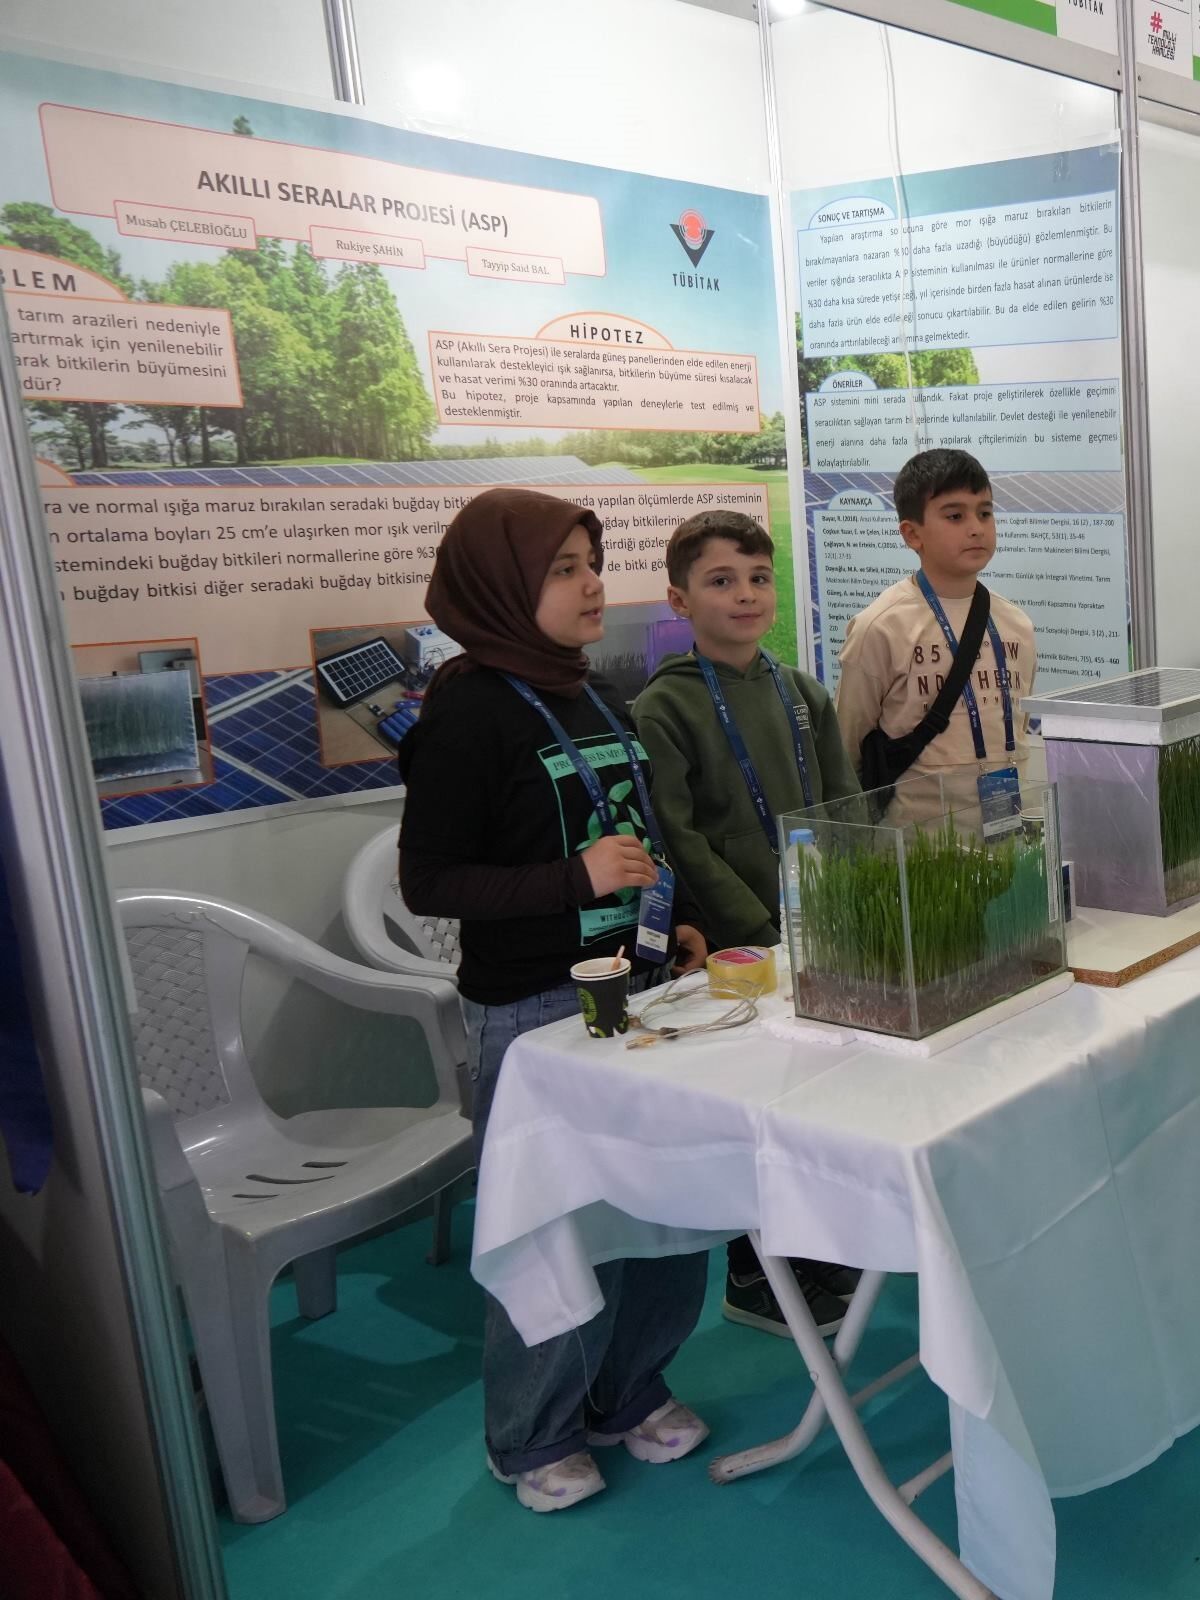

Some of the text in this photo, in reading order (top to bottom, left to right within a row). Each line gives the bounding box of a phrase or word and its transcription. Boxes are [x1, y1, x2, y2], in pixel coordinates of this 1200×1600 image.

[198, 170, 508, 237] AKILLI SERALAR PROJESİ (ASP)
[818, 207, 885, 223] SONUÇ VE TARTIŞMA
[126, 213, 247, 239] Musab ÇELEBİOĞLU
[820, 199, 1112, 245] Yapılan araştırma göre mor ışığa maruz bırakılan bitkilerin
[336, 239, 403, 257] Rukiye ŞAHİN
[864, 251, 890, 261] nazaran
[913, 245, 931, 255] daha
[934, 240, 952, 253] fazla
[987, 233, 1031, 248] (büyüdüğü)
[1103, 224, 1113, 233] Bu
[511, 261, 529, 273] Said
[531, 264, 549, 275] BAL
[911, 249, 1113, 278] sisteminin kullanılması ile ürünler normallerine göre
[673, 272, 720, 291] TÜBİTAK
[968, 272, 1102, 295] birden hasat alınan ürünlerde
[1043, 300, 1068, 310] edilen
[18, 308, 221, 337] tarım arazileri nedeniyle
[570, 323, 644, 344] HİPOTEZ
[11, 332, 223, 357] artırmak için yenilenebilir
[435, 340, 751, 372] ASP (Akıllı Sera Projesi) ile seralarda güneş panellerinden elde edilen enerji
[56, 355, 130, 373] bitkilerin
[137, 360, 227, 378] büyümesini
[437, 357, 752, 385] kullanılarak destekleyici ışık sağlanırsa, bitkilerin büyüme süresi kısalacak
[439, 374, 620, 392] ve hasat verimi %30 oranında artacaktır.
[832, 379, 863, 389] ÖNERİLER
[974, 387, 1081, 402] proje geliştirilerek özellikle
[442, 390, 455, 400] Bu
[466, 390, 506, 403] hipotez,
[515, 393, 539, 405] proje
[547, 394, 595, 406] kapsamında
[603, 399, 632, 408] yapılan
[640, 399, 683, 410] deneylerle
[691, 401, 705, 410] test
[712, 402, 739, 413] edilmiş
[444, 406, 522, 419] desteklenmiştir.
[1000, 411, 1056, 421] Devlet desteği
[1051, 432, 1081, 442] sisteme
[68, 503, 90, 514] ve
[96, 499, 158, 514] normal
[164, 499, 200, 516] ışığa
[205, 500, 256, 513] maruz
[259, 498, 325, 512] bırakılan
[330, 497, 389, 511] seradaki
[392, 497, 440, 512] buğday
[597, 495, 635, 511] yapılan
[638, 494, 694, 509] ölçümlerde
[696, 494, 714, 505] ASP
[716, 494, 762, 504] sisteminin
[840, 498, 872, 507] KAYNAKÇA
[67, 528, 148, 543] ortalama
[154, 527, 211, 544] boyları
[216, 526, 236, 540] 25
[283, 524, 349, 541] ulaşırken
[355, 524, 383, 536] mor
[388, 522, 409, 538] ışık
[633, 515, 686, 527] bitkilerinin
[158, 554, 218, 572] buğday
[223, 552, 282, 568] bitkileri
[287, 549, 380, 564] normallerine
[384, 547, 413, 564] göre
[73, 585, 139, 603] buğday
[147, 582, 197, 598] bitkisi
[204, 580, 244, 597] diğer
[251, 577, 314, 593] seradaki
[320, 575, 371, 590] buğday
[377, 572, 432, 586] bitkisine
[625, 559, 648, 571] bitki
[918, 670, 1020, 695] NOHERN
